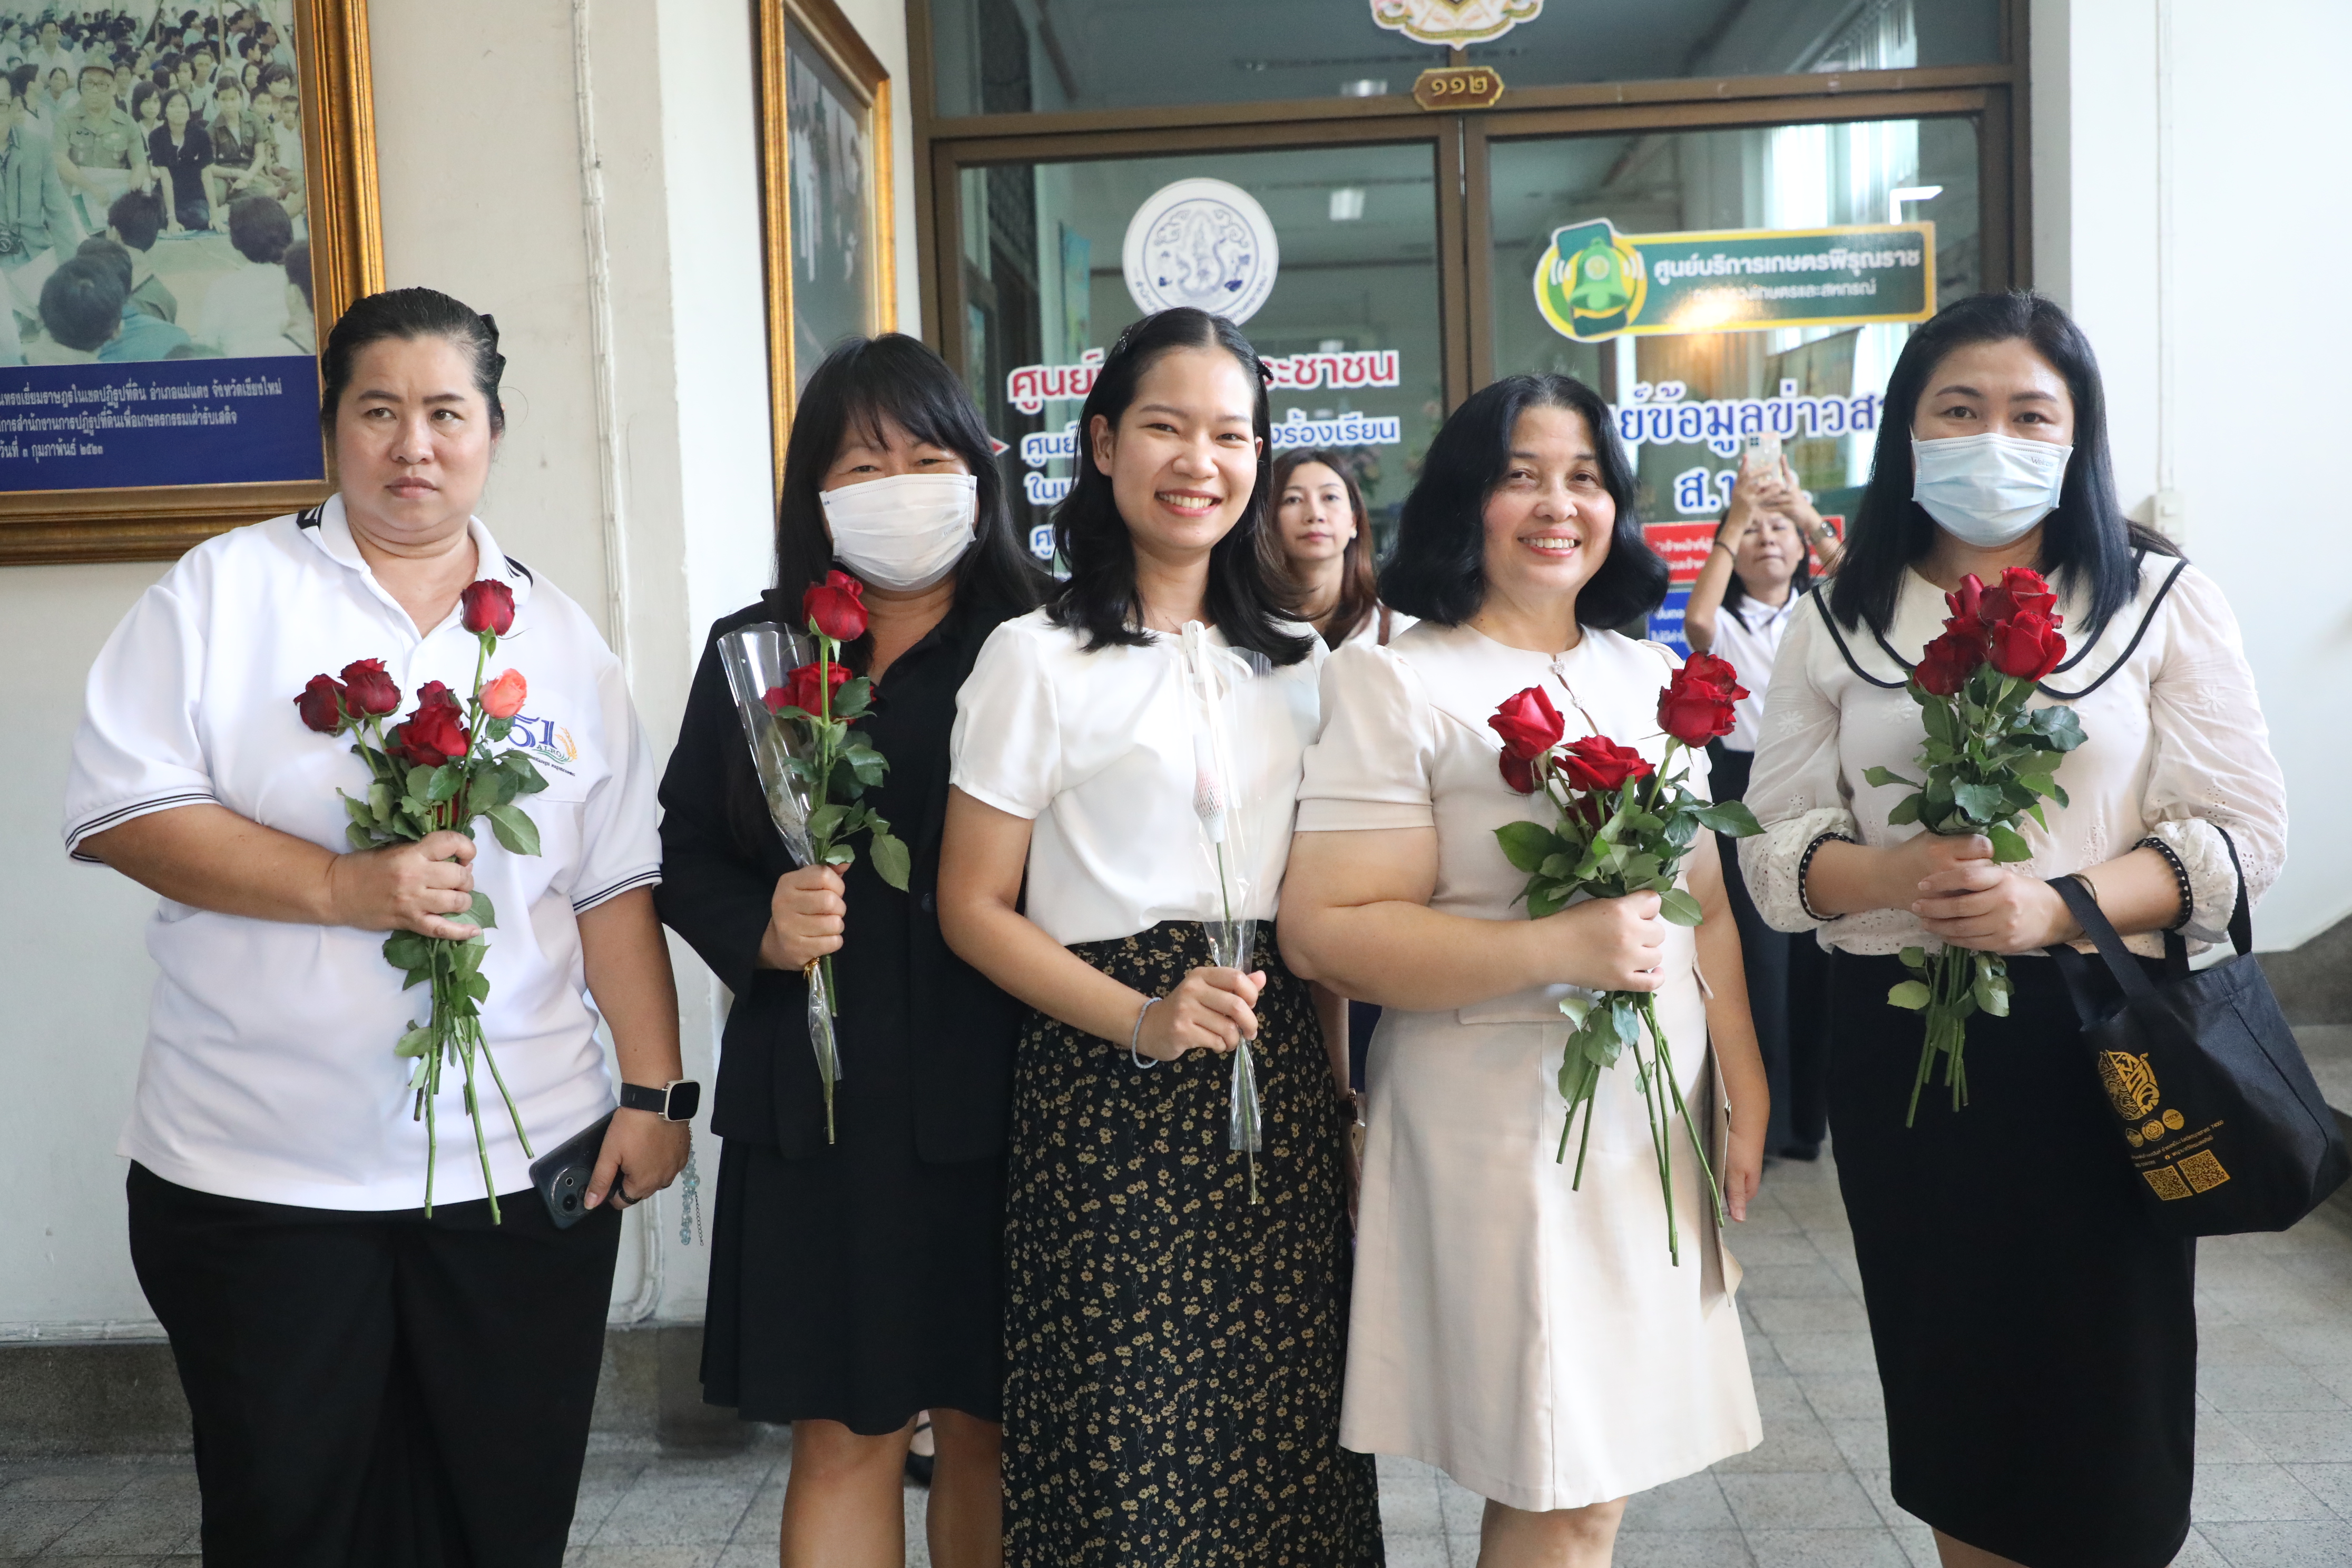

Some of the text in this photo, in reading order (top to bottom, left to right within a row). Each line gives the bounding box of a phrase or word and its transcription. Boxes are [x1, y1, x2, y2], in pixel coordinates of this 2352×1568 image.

[1431, 74, 1487, 96] ๑๑๒
[1653, 248, 1920, 286] ศูนย์บริการเกษตรพิรุณราช
[150, 380, 209, 400] อำเภอแม่แตง
[211, 375, 283, 398] จังหวัดเชียงใหม่
[1012, 354, 1102, 409] ศูนย์
[0, 404, 238, 436] การสำนักงานการปฏิรูปที่ดินเพื่อเกษตรกรรมเฝ้ารับเสด็จ
[1620, 384, 1885, 453] ย์ข้อมูลข่าวส
[31, 437, 77, 464] กุมภาพันธ์
[536, 744, 562, 758] ALRO
